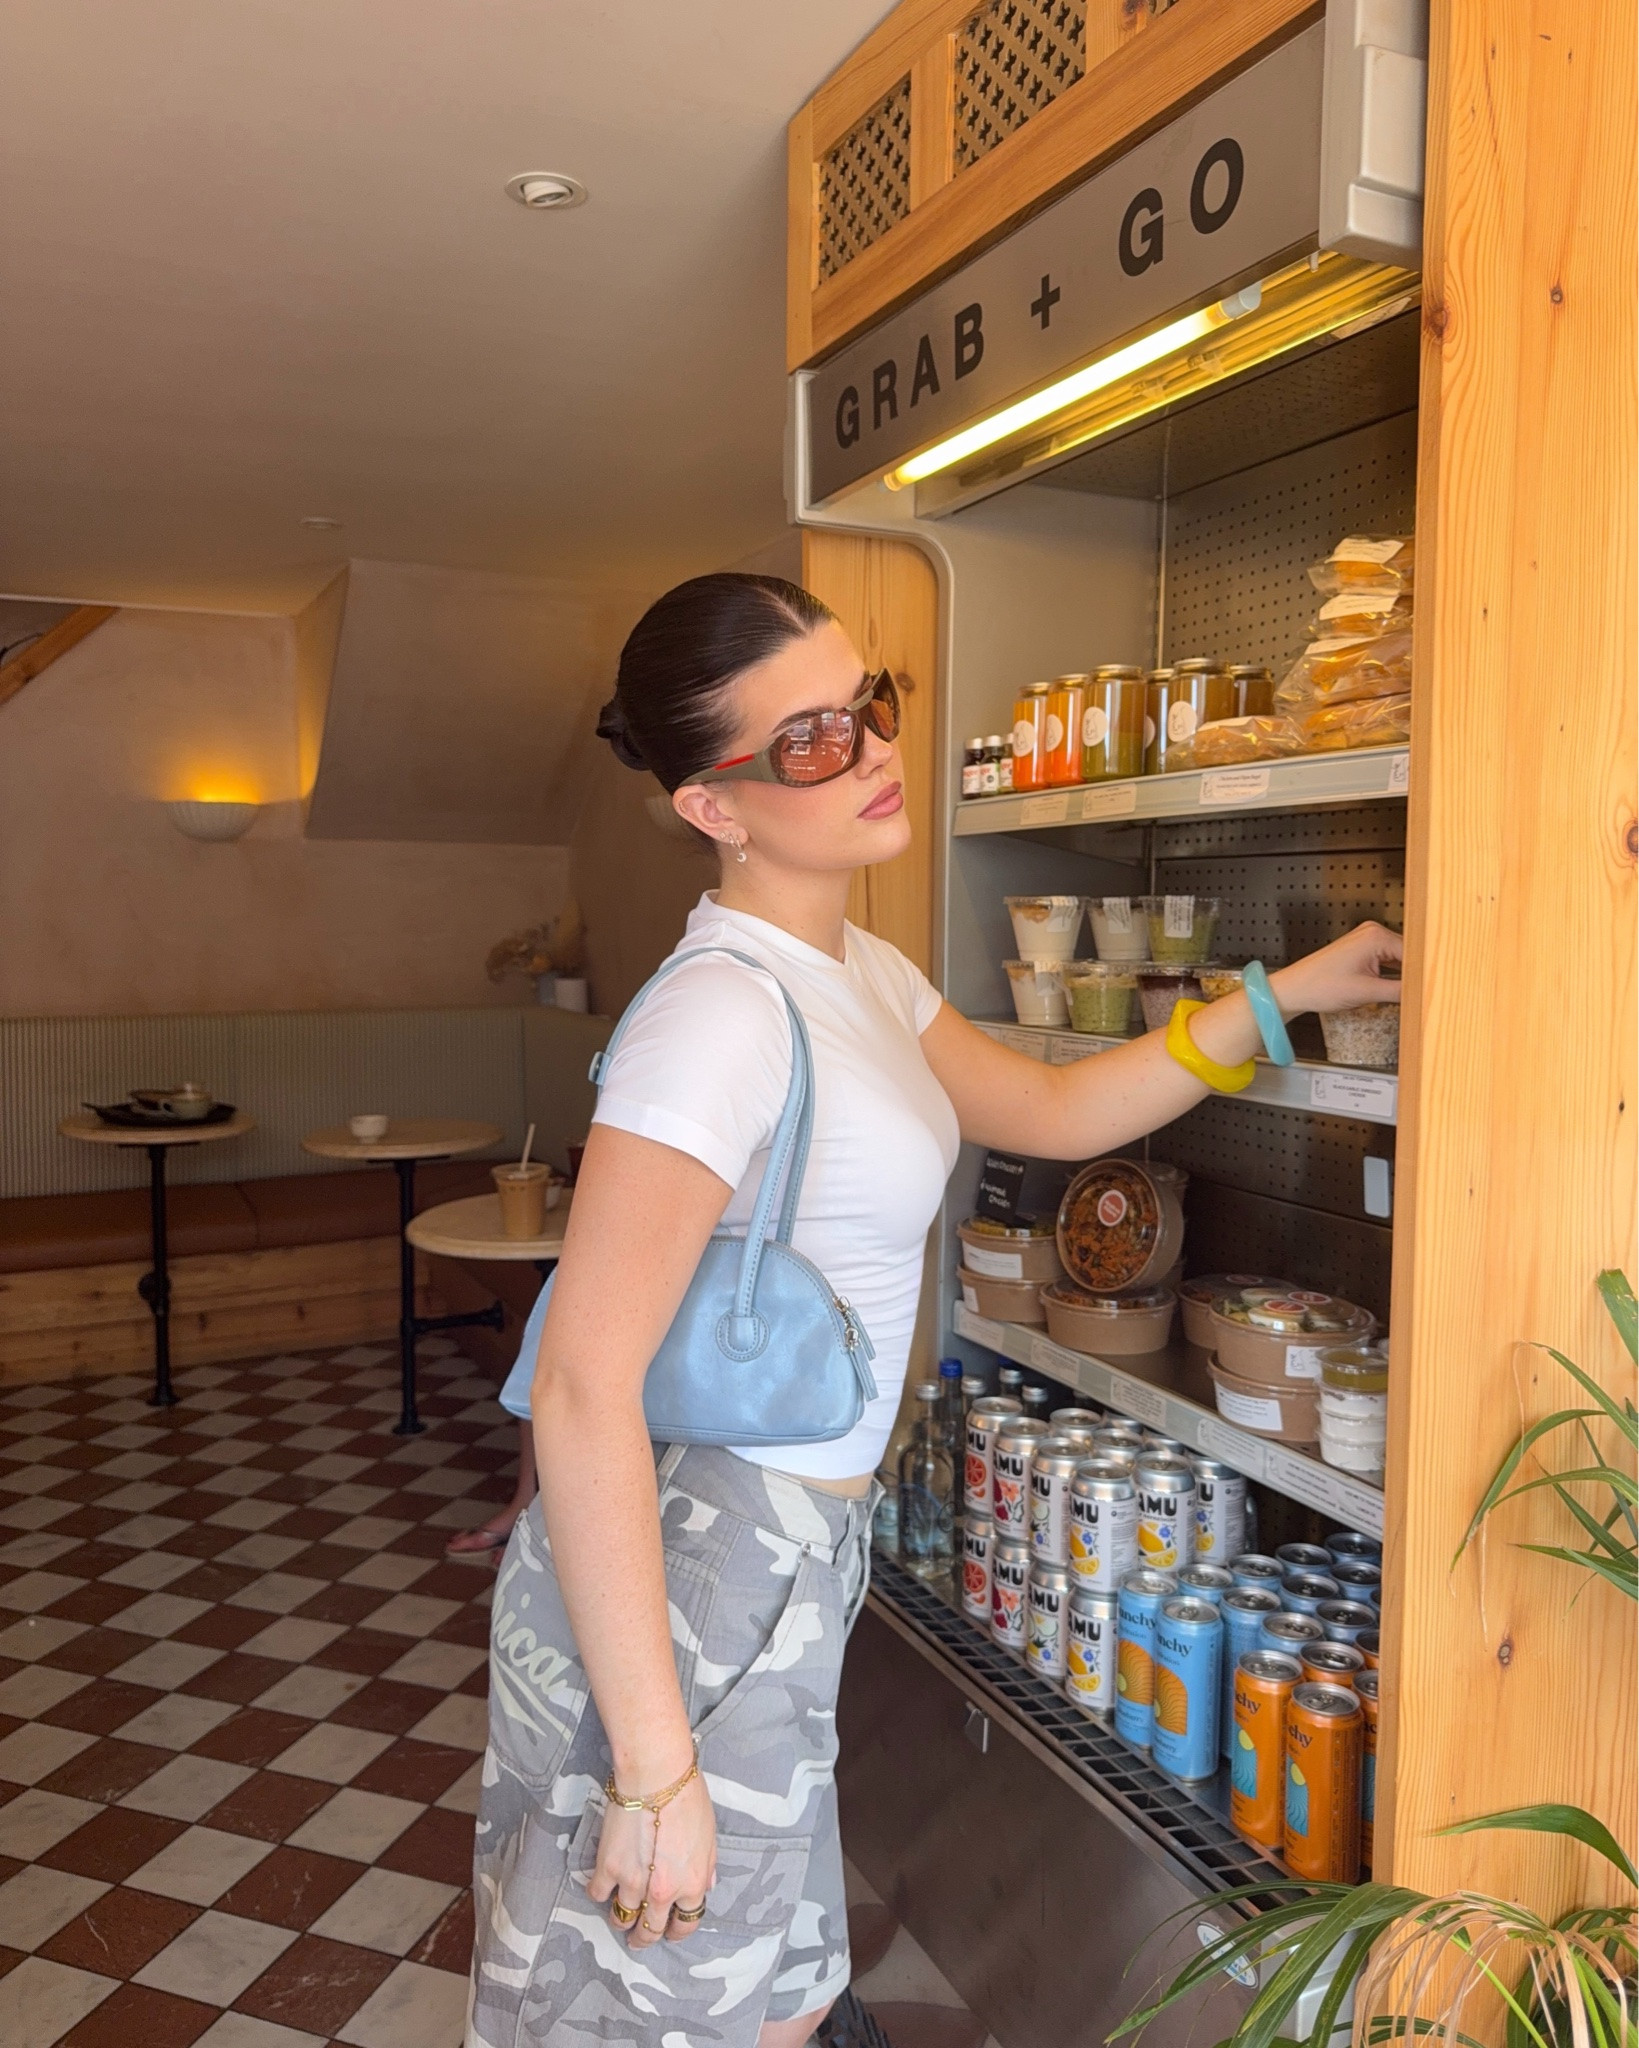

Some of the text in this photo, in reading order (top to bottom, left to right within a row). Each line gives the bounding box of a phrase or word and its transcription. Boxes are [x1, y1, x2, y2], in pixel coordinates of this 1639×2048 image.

[834, 137, 1245, 451] GRAB + GO
